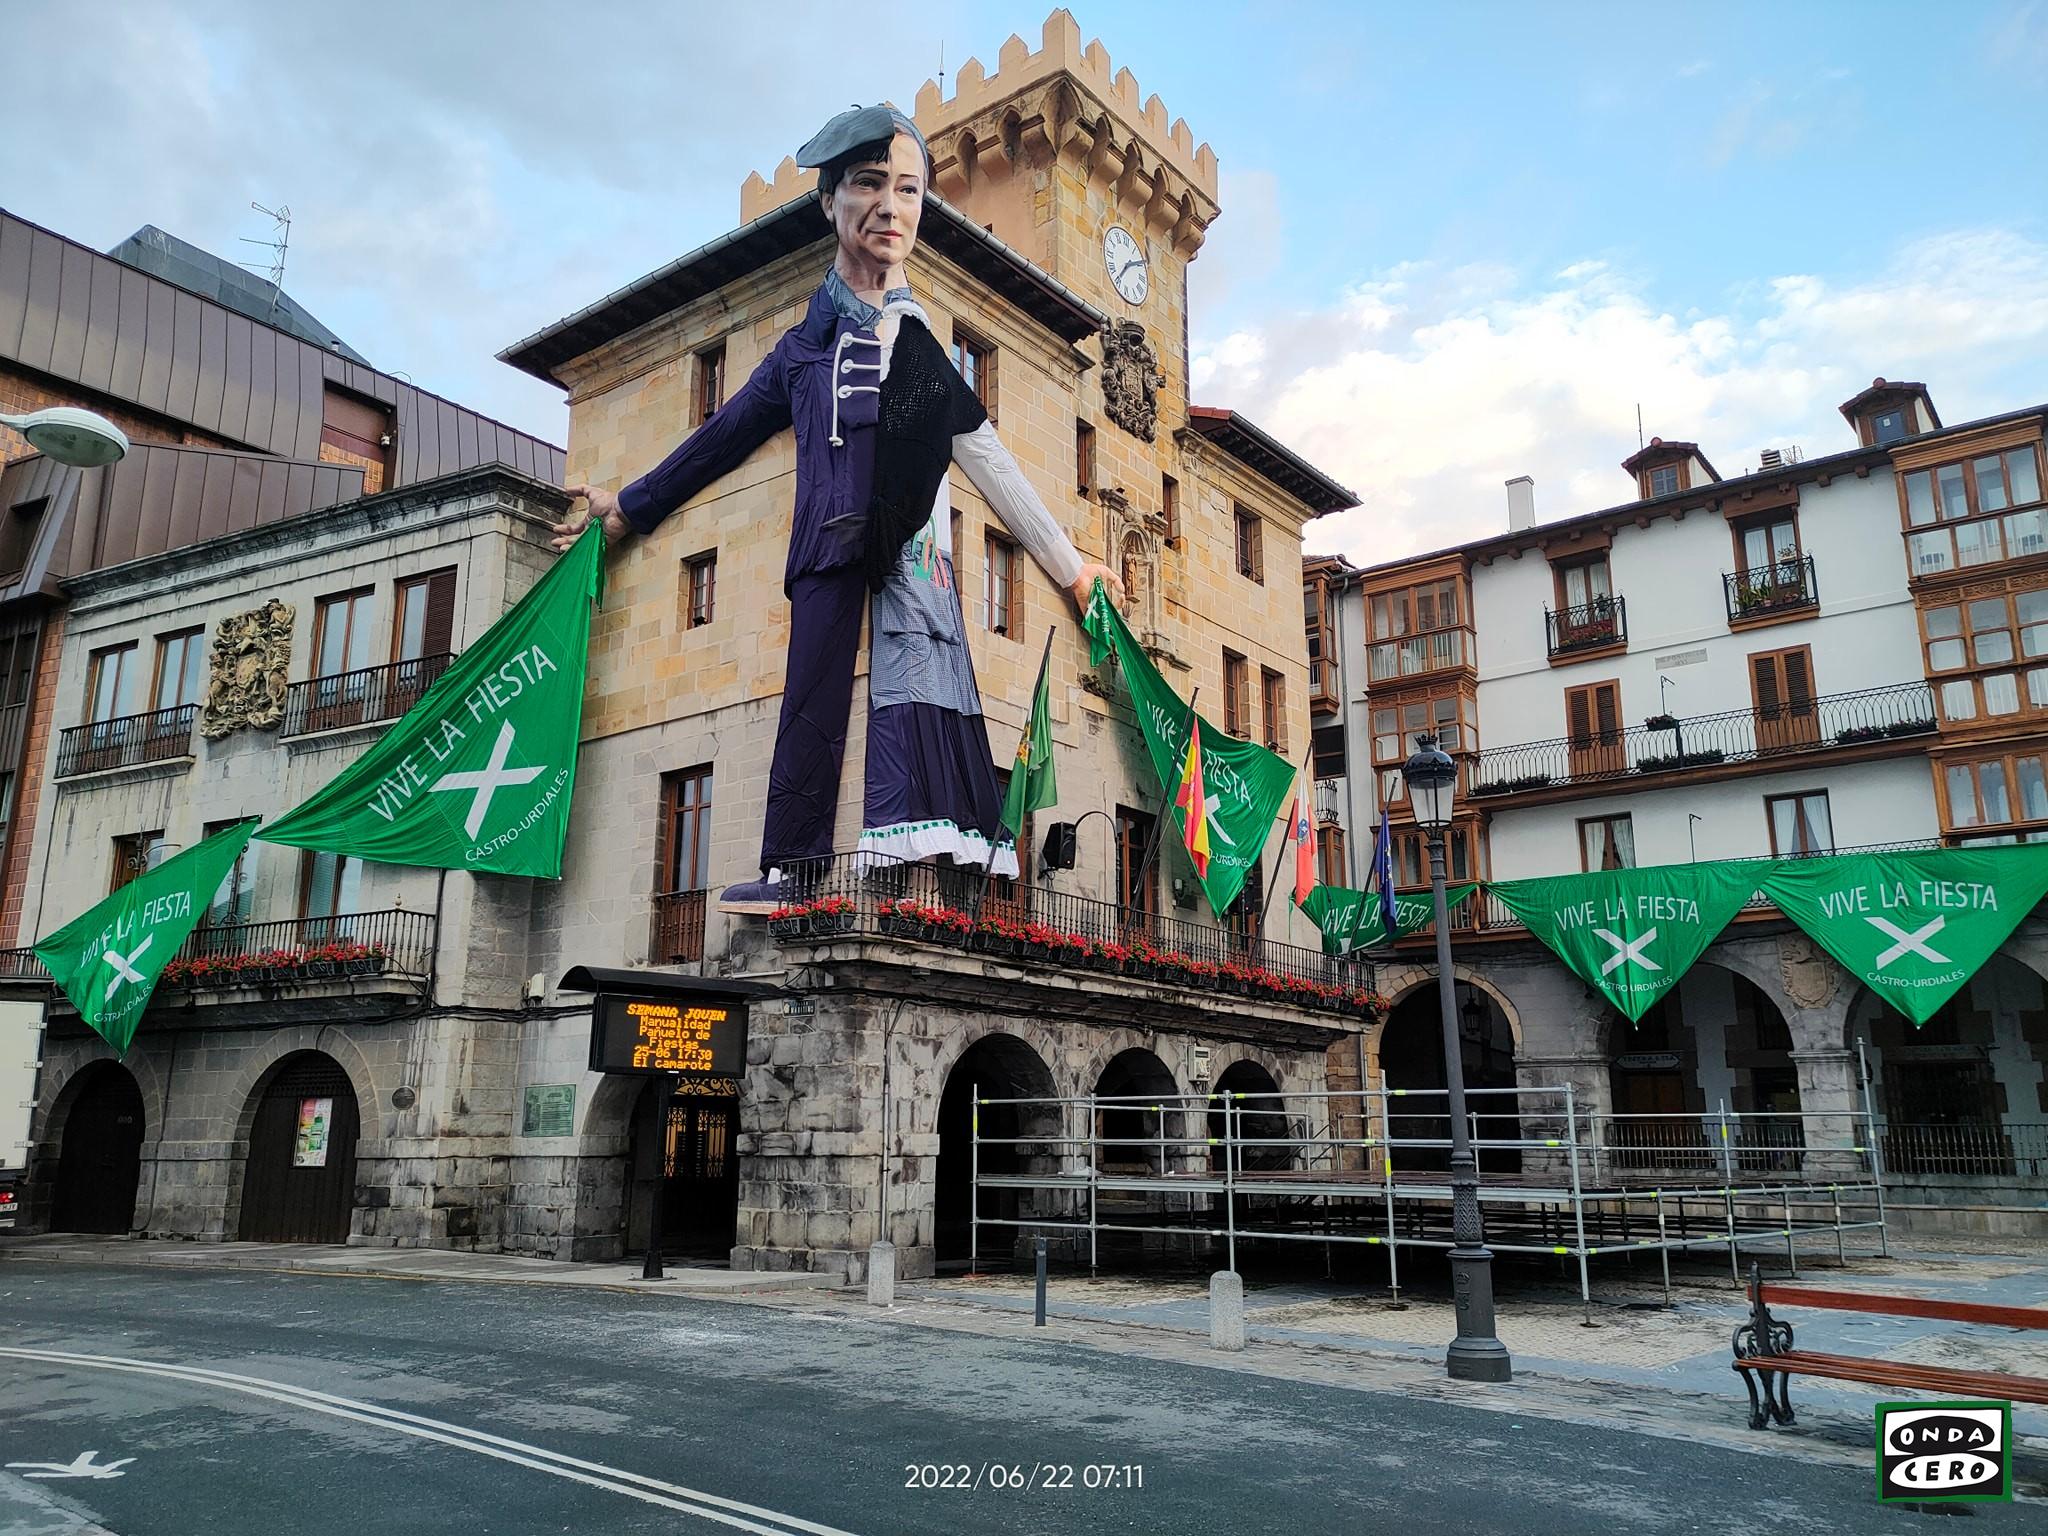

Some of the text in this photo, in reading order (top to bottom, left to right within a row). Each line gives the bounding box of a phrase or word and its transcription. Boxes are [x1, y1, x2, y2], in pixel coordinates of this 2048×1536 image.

[367, 644, 558, 822] VIVE LA FIESTA
[1202, 747, 1254, 811] FIESTA
[465, 767, 569, 862] CASTRO-URDIALES
[141, 890, 191, 929] FIESTA
[1555, 895, 1700, 931] VIVE LA FIESTA
[1818, 881, 1998, 919] VIVE LA FIESTA
[1321, 900, 1431, 936] VIVE LA IESTA
[1866, 968, 1966, 988] CASTRO-URDIALES
[626, 1003, 727, 1022] SEMANA JOVEN
[640, 1015, 711, 1030] Manualidad
[639, 1025, 711, 1040] Pañuelo de
[648, 1037, 699, 1049] Fiestas
[633, 1056, 712, 1071] El camarote
[634, 1045, 712, 1060] 25-06 17:30
